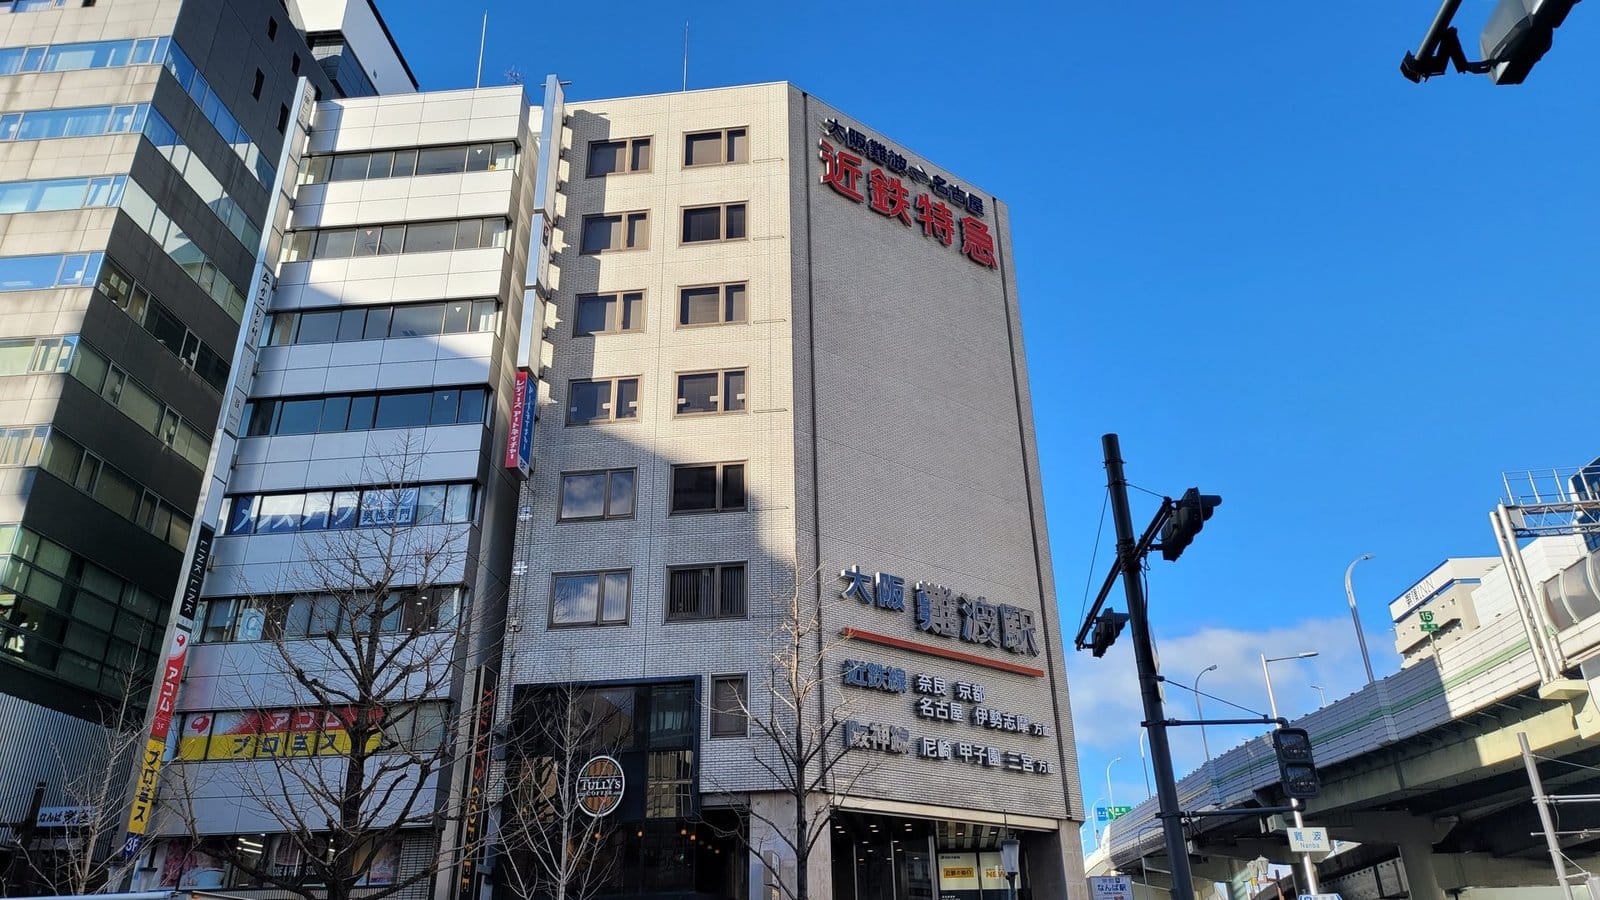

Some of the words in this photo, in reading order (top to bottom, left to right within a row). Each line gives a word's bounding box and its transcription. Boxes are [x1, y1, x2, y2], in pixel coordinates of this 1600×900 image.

[818, 118, 908, 175] 大阪難波
[930, 174, 984, 217] 名古屋
[819, 137, 999, 270] 近鉄特急
[840, 564, 905, 612] 大阪
[914, 580, 1041, 657] 難波駅
[1420, 611, 1433, 621] 15
[160, 666, 178, 712] アコム
[842, 659, 908, 694] 近鉄線
[917, 673, 946, 696] 奈良
[956, 680, 986, 703] 京都
[155, 722, 165, 731] 3F
[269, 711, 341, 731] アコム
[918, 697, 964, 722] 名古屋
[973, 706, 1031, 732] 伊勢志摩
[1033, 723, 1051, 738] 方面
[232, 734, 337, 755] プロミス
[844, 720, 910, 755] 阪神線
[921, 737, 951, 760] 尼崎
[958, 742, 1001, 766] 甲子園
[1006, 751, 1035, 773] 三宮
[133, 750, 160, 823] プロミス
[580, 779, 621, 791] TULLY'S
[125, 837, 139, 852] 3F
[1293, 831, 1322, 841] 難波
